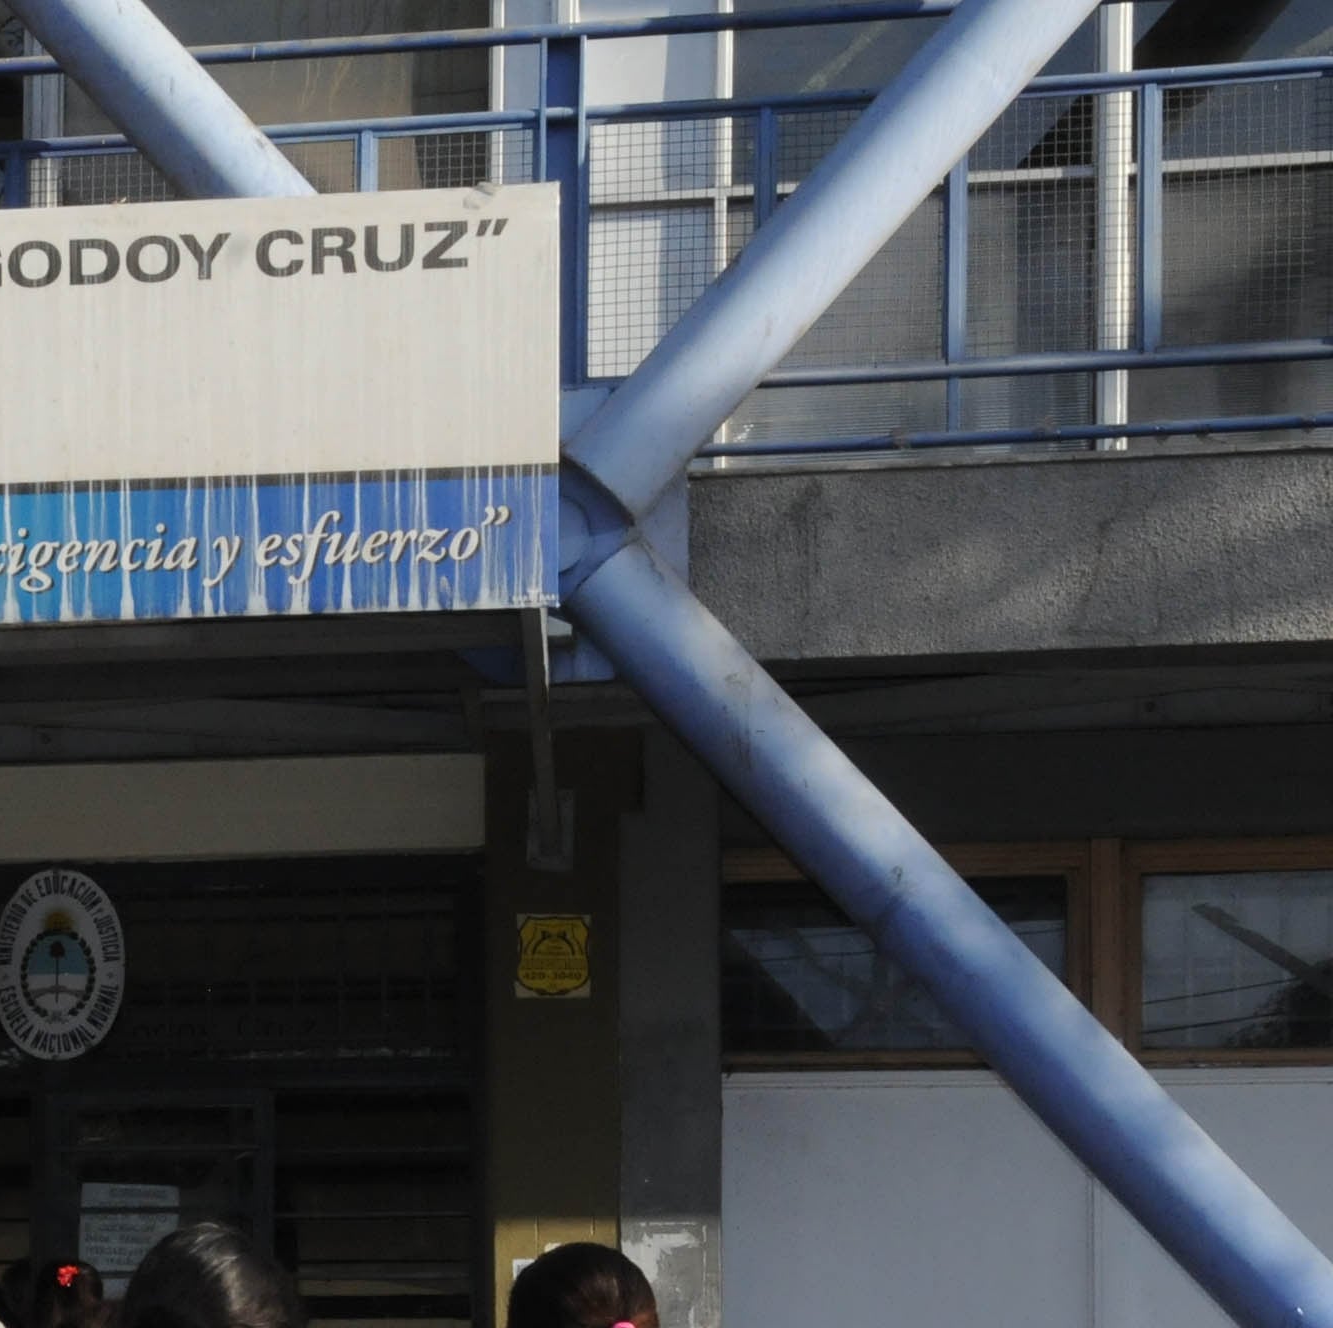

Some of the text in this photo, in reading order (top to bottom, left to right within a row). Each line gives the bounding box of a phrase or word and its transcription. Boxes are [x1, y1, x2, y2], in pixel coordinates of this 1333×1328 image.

[207, 533, 239, 587] y
[21, 888, 39, 907] DE
[92, 912, 122, 963] JUSTICIA
[31, 1025, 97, 1053] NACIONAL
[88, 984, 120, 1031] NORMAL
